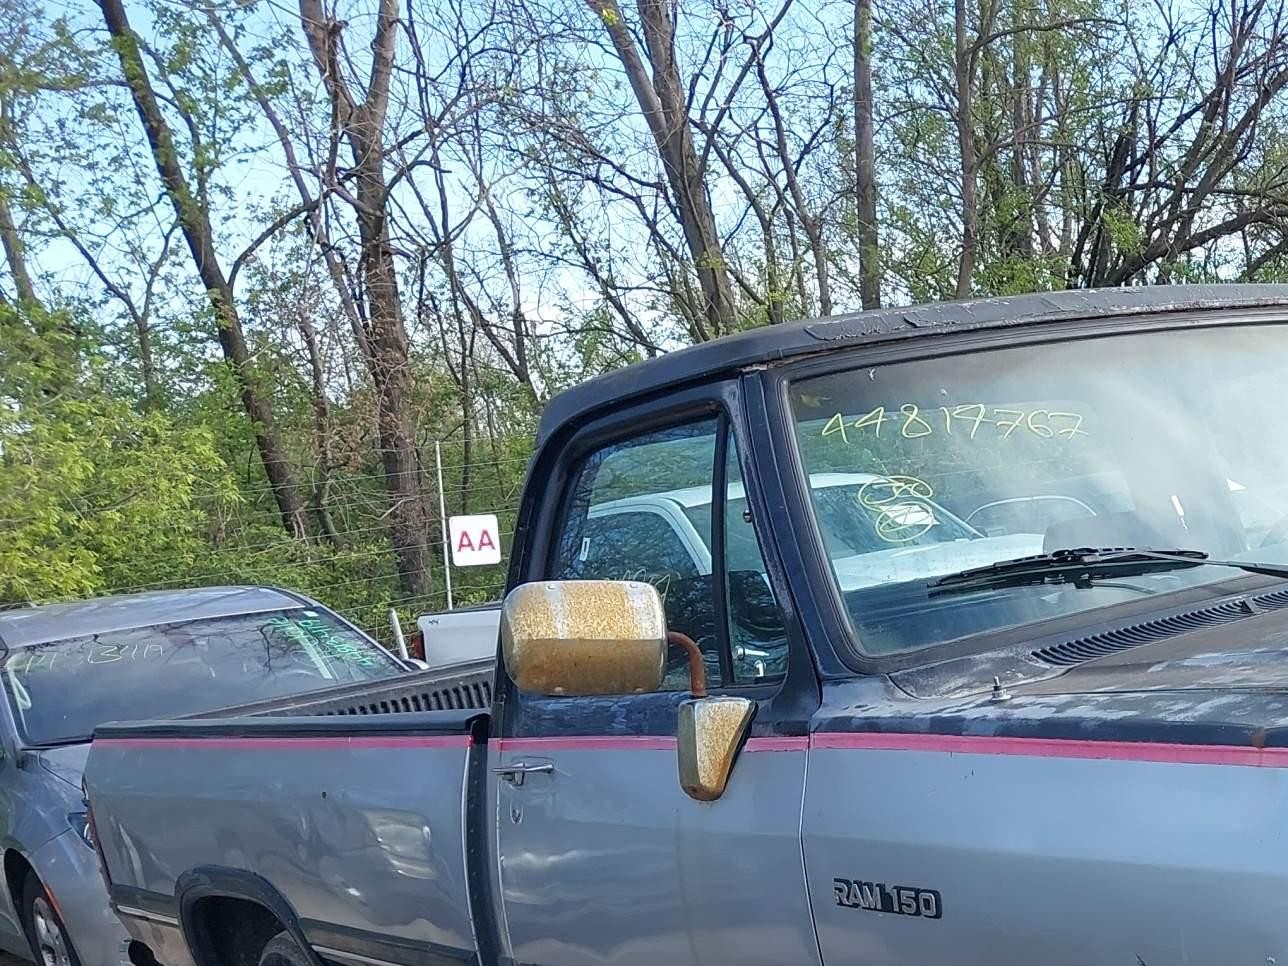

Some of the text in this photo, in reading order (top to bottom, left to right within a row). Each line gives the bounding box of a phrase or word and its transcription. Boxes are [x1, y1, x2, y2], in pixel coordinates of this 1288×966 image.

[457, 530, 496, 552] AA
[833, 878, 942, 919] RAM 150
